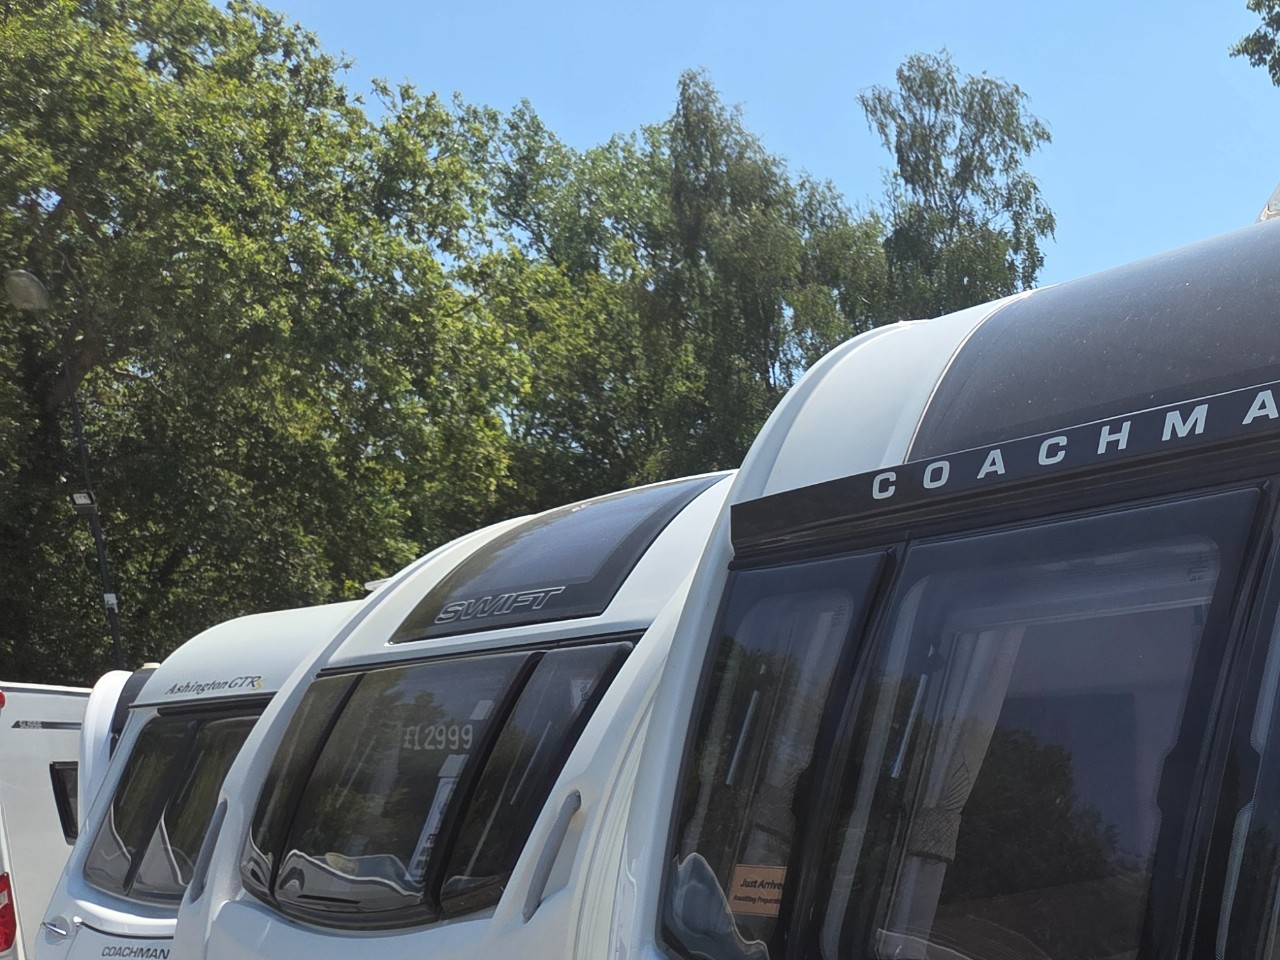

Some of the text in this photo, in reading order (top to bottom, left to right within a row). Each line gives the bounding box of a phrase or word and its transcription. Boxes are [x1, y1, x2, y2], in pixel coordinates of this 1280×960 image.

[434, 586, 566, 624] SWIFT
[165, 681, 229, 696] Ashington
[403, 723, 474, 751] £12999
[740, 879, 784, 891] Just Arrive
[101, 946, 171, 960] COACHMAN
